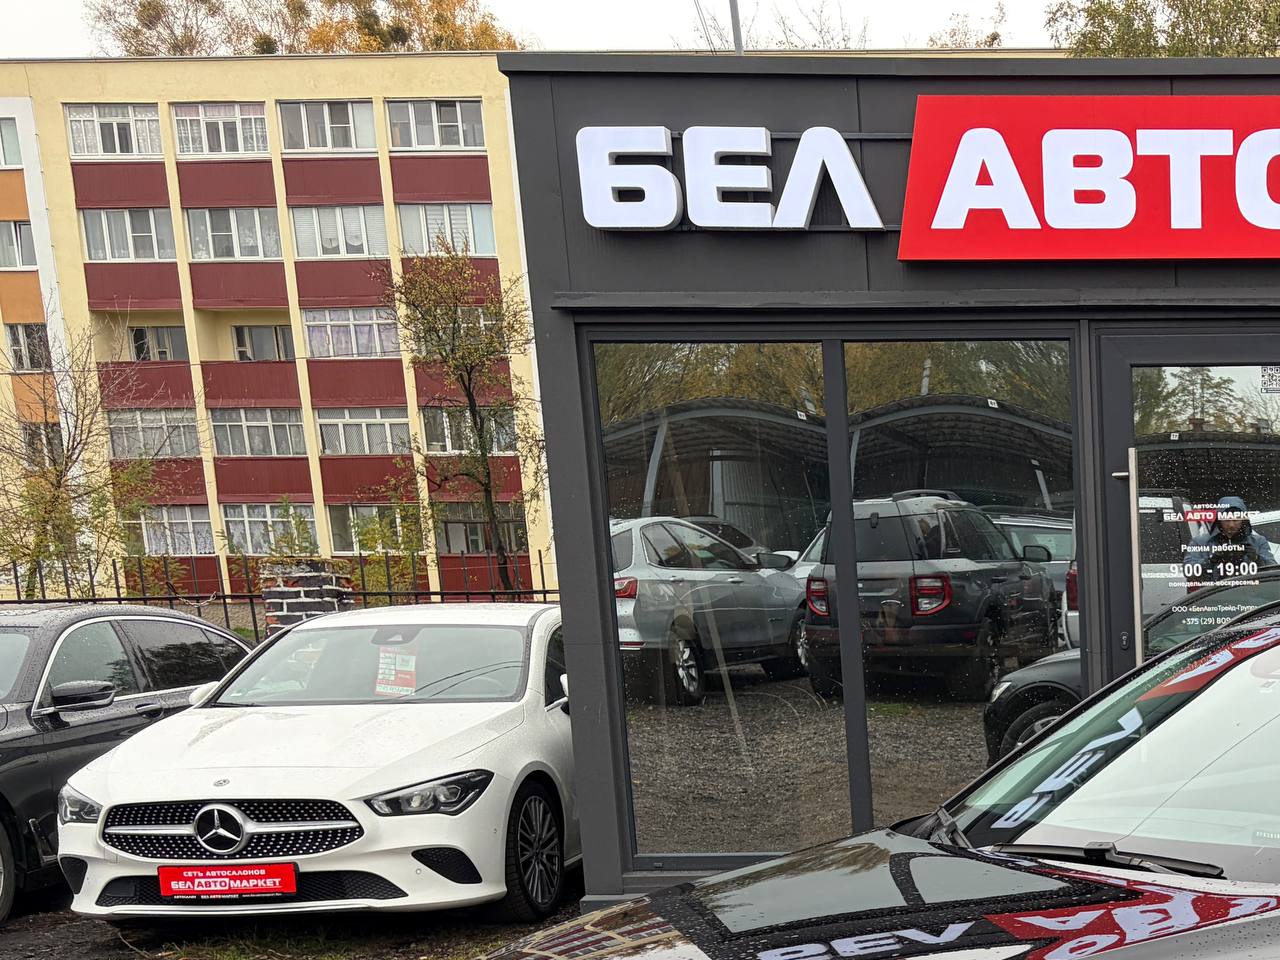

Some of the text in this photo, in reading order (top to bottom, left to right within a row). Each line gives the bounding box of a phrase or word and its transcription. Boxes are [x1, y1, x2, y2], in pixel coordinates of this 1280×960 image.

[575, 125, 886, 231] БЕЛ
[1163, 512, 1184, 521] БЕЛ
[1186, 512, 1214, 520] АВТО
[1181, 543, 1245, 553] Режим работы
[1169, 563, 1202, 577] 9:00
[1217, 562, 1258, 576] 19:00
[1200, 617, 1215, 625] (29)
[205, 869, 266, 877] АВТОСАЛОНОВ
[170, 878, 282, 889] БЕЛ АВТО МАРКЕТ
